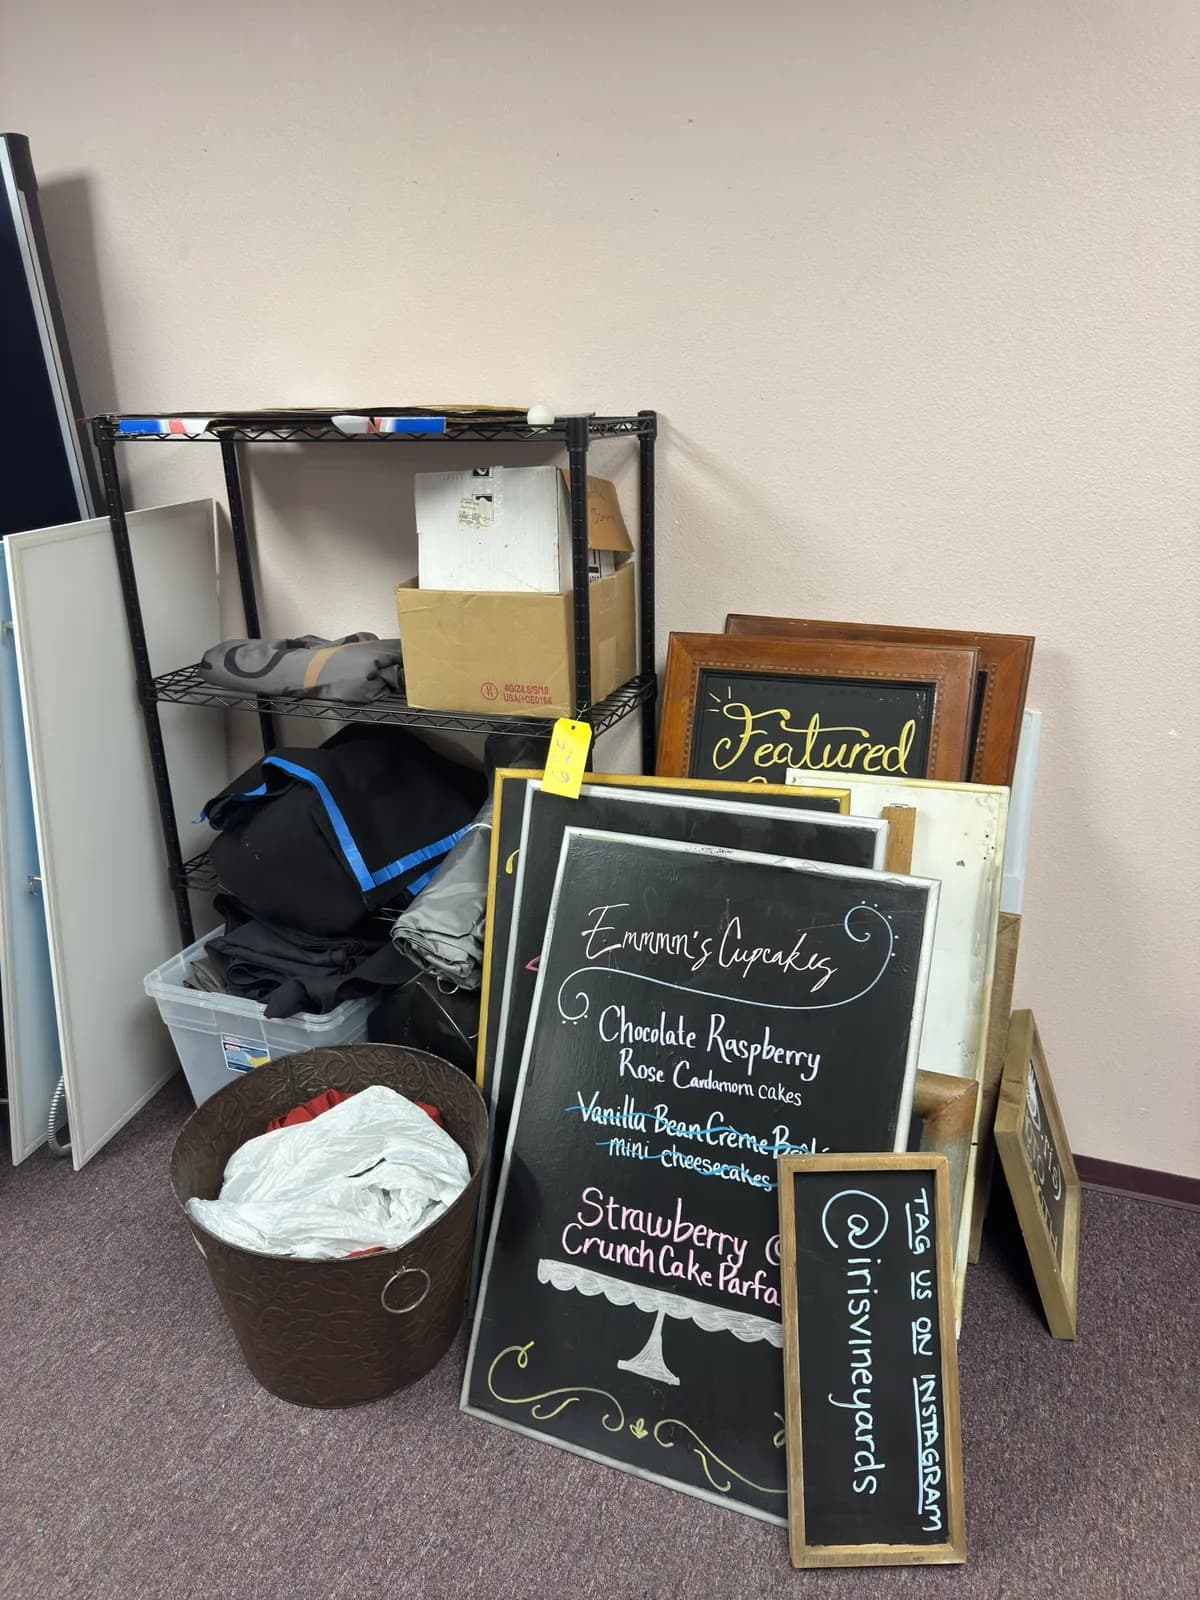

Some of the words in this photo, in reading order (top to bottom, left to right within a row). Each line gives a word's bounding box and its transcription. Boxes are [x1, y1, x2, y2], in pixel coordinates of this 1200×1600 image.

[712, 703, 916, 775] Featured
[718, 917, 838, 993] Cupcakes
[598, 1005, 697, 1049] Chocolate
[706, 1013, 821, 1082] Raspberry
[619, 1047, 665, 1083] Rose
[672, 1060, 754, 1096] Cardamom
[758, 1082, 802, 1106] cakes
[577, 1090, 647, 1134] Vanilla
[654, 1104, 702, 1140] Bean
[609, 1137, 649, 1161] mini
[661, 1144, 773, 1192] cheesecakes
[577, 1187, 749, 1268] Strawberry
[912, 1187, 932, 1256] TAG
[562, 1222, 655, 1274] Crunch
[658, 1245, 713, 1287] Cake
[719, 1261, 782, 1306] Parfa
[915, 1269, 933, 1300] US
[821, 1189, 890, 1495] @irisvineyards
[915, 1316, 934, 1356] ON
[918, 1374, 943, 1532] INSTAGRAM
